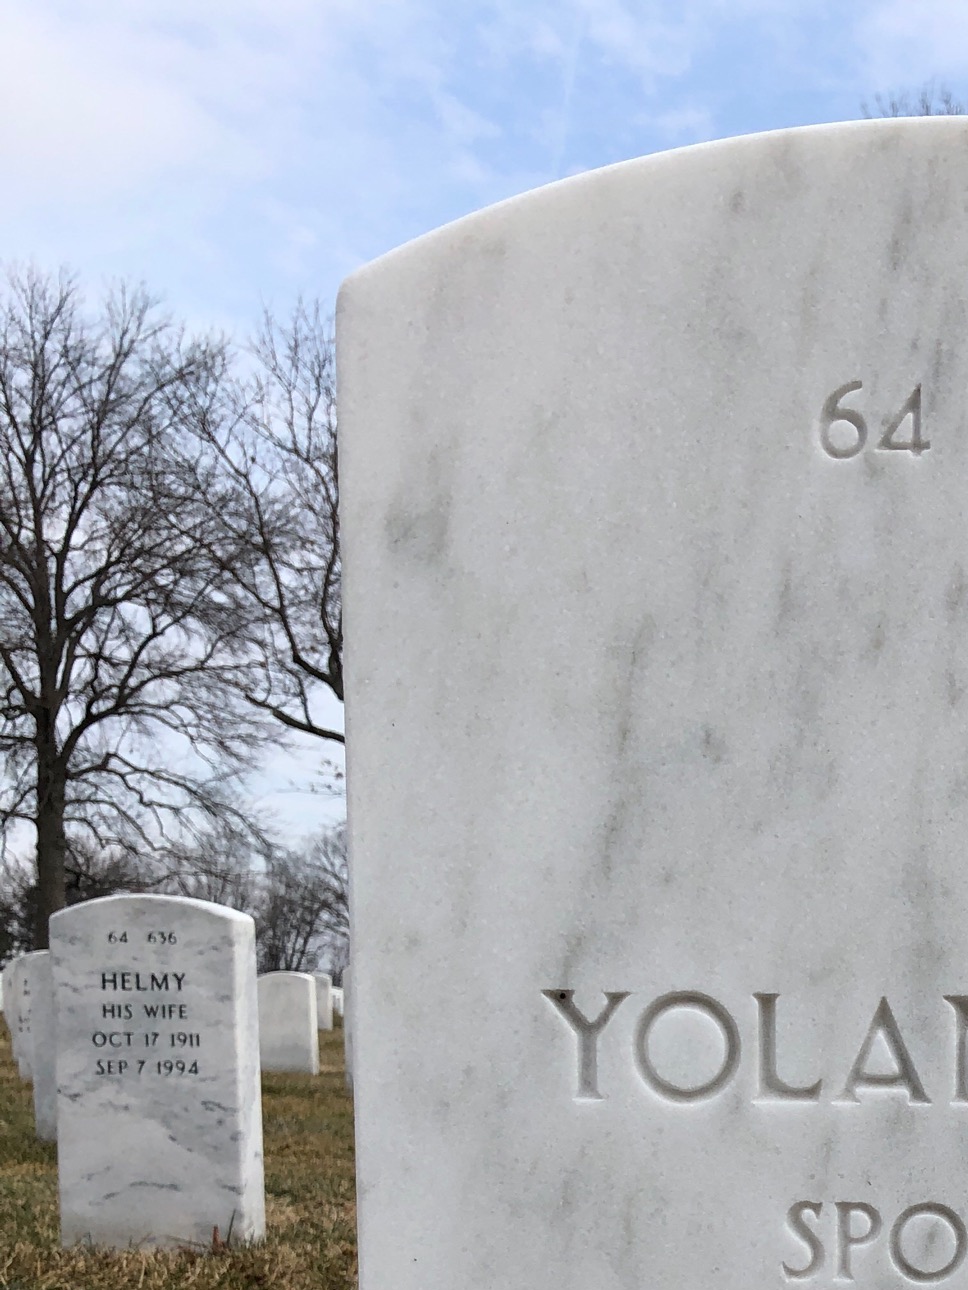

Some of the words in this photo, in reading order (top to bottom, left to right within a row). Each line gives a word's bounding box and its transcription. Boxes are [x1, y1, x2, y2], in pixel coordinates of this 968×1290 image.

[820, 379, 931, 460] 64
[108, 931, 128, 944] 64
[147, 931, 177, 945] 636
[101, 972, 186, 991] HELMY
[102, 1003, 133, 1020] HIS
[144, 1004, 188, 1020] WIFE
[92, 1031, 134, 1048] OCT
[145, 1032, 160, 1048] 17
[170, 1032, 200, 1048] 1911
[96, 1059, 128, 1076] SEP
[138, 1060, 146, 1075] 7
[157, 1060, 199, 1077] 1994
